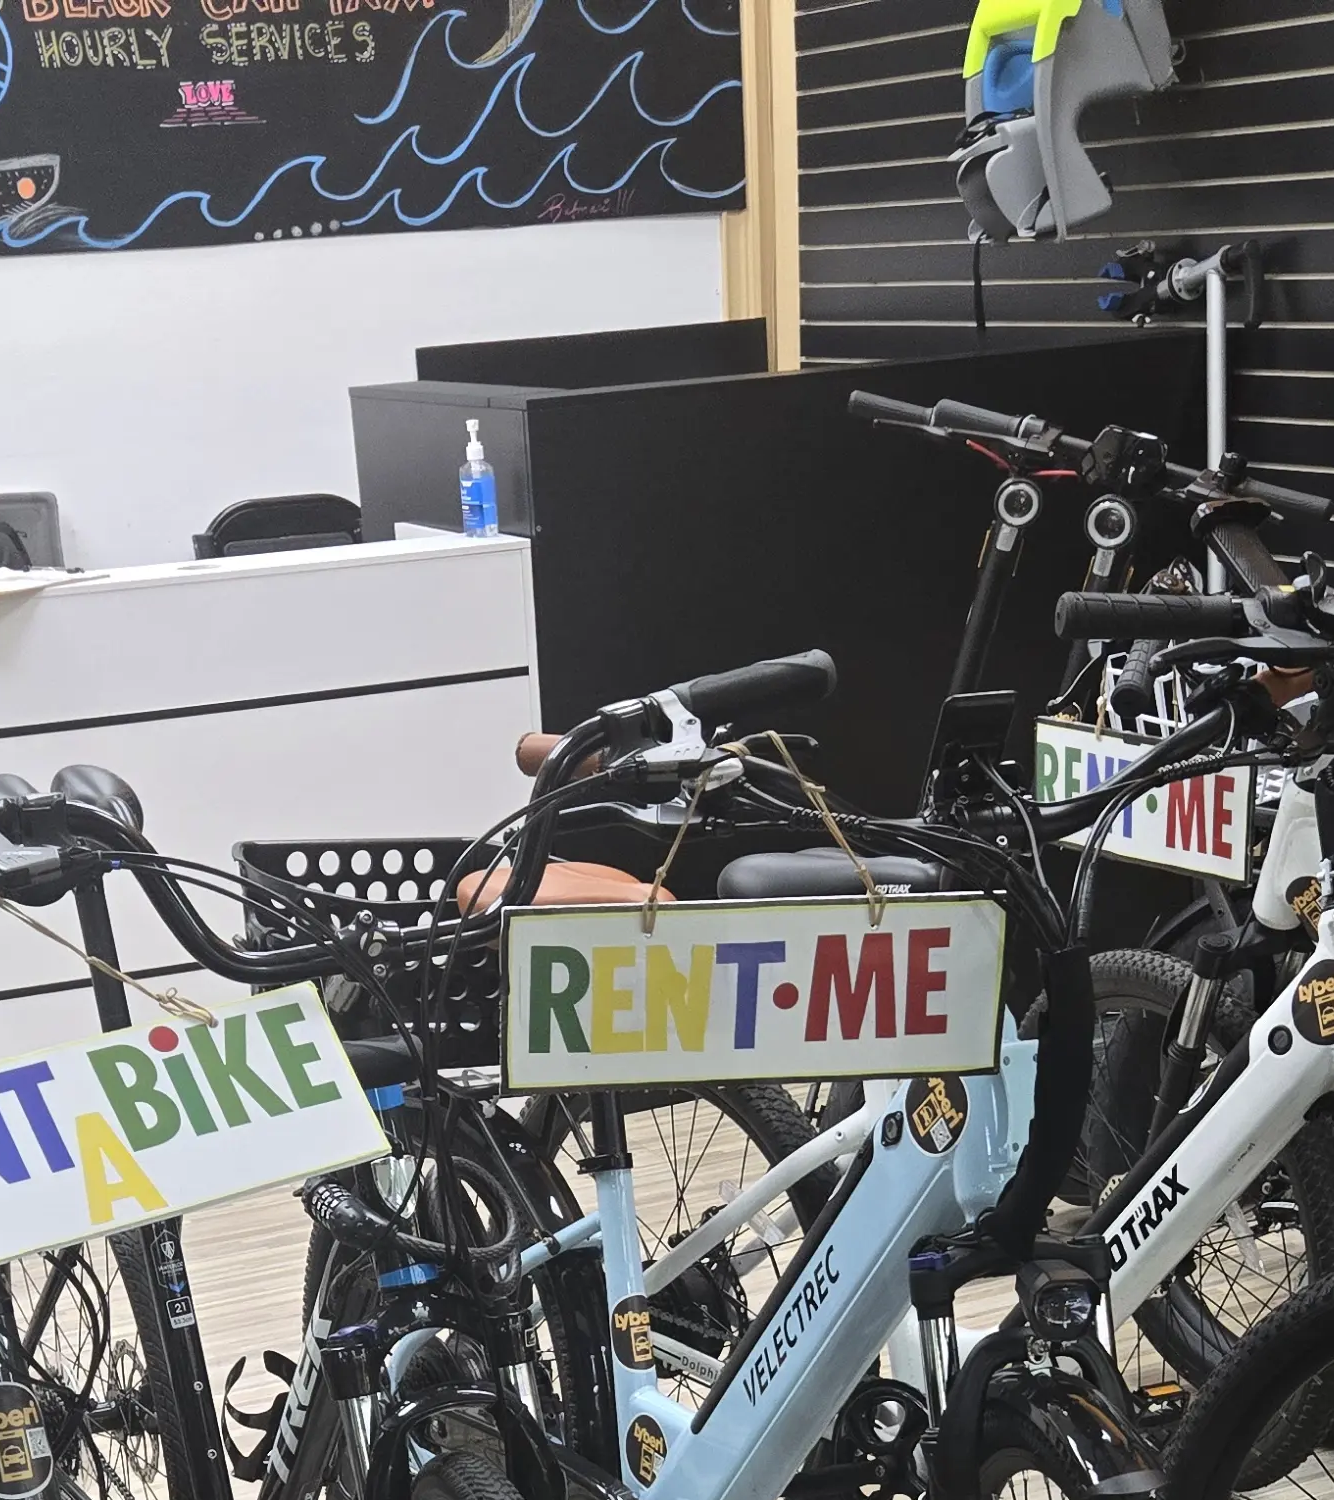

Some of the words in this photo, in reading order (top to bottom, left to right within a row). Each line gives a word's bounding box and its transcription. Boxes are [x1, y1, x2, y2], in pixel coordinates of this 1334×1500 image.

[34, 24, 173, 69] HOURLY
[199, 21, 375, 66] SERVICES
[178, 80, 235, 109] LOVE
[74, 1111, 168, 1225] A
[1108, 1167, 1190, 1273] OTRAX
[681, 1355, 720, 1381] Dolphi
